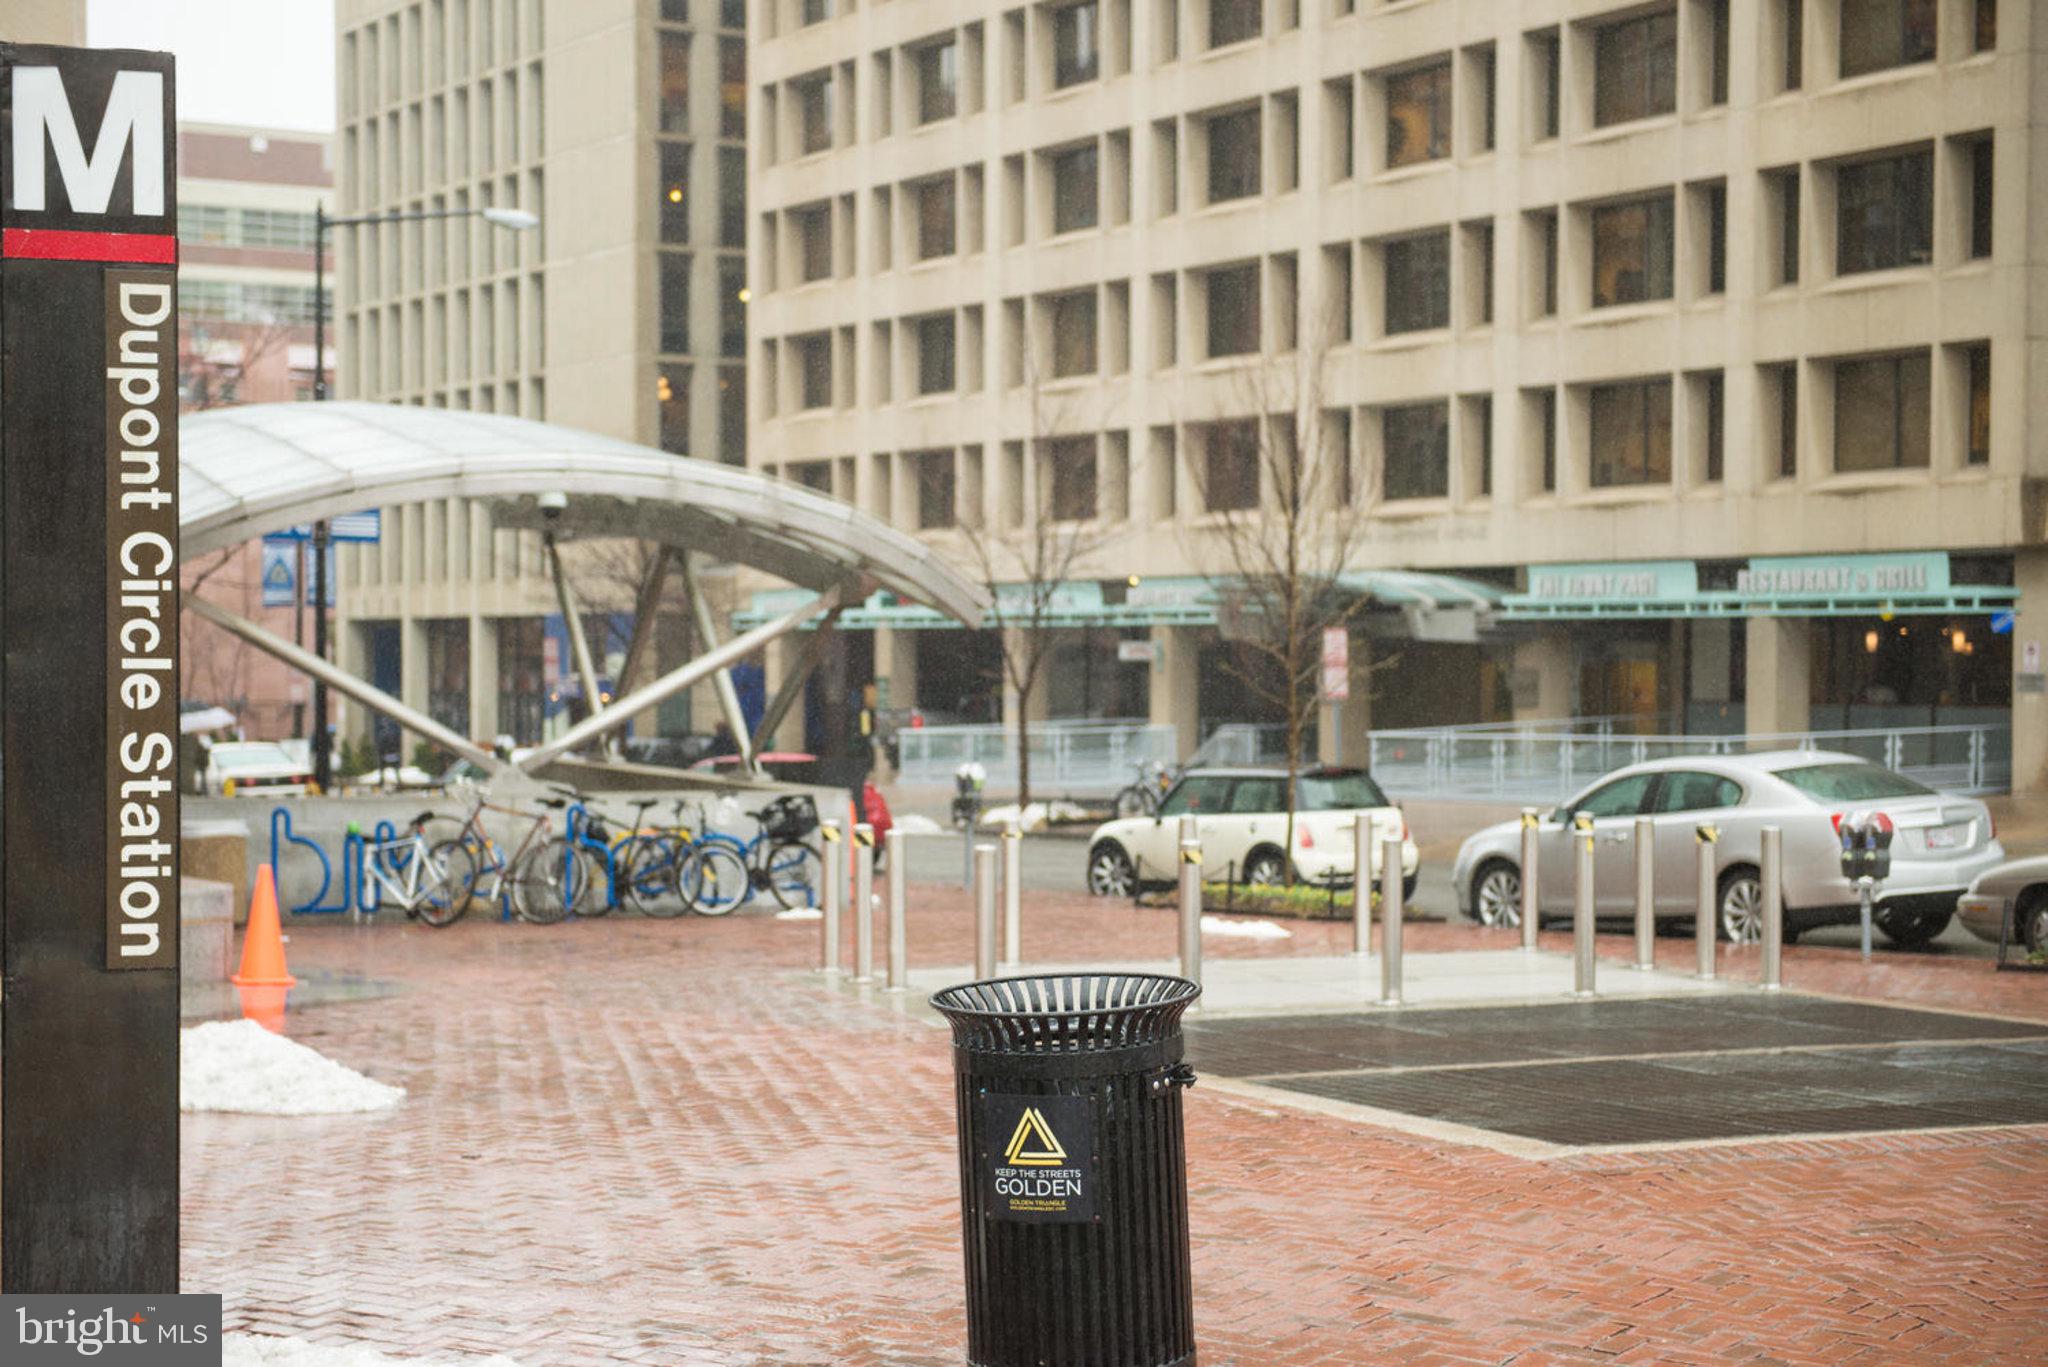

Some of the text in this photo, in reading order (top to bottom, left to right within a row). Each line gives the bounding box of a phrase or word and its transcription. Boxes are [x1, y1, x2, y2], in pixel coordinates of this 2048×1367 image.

[11, 66, 165, 217] M
[106, 282, 174, 957] Dupont Circle Station
[994, 1167, 1082, 1180] KEEP THE STREETS
[994, 1178, 1082, 1197] GOLDEN
